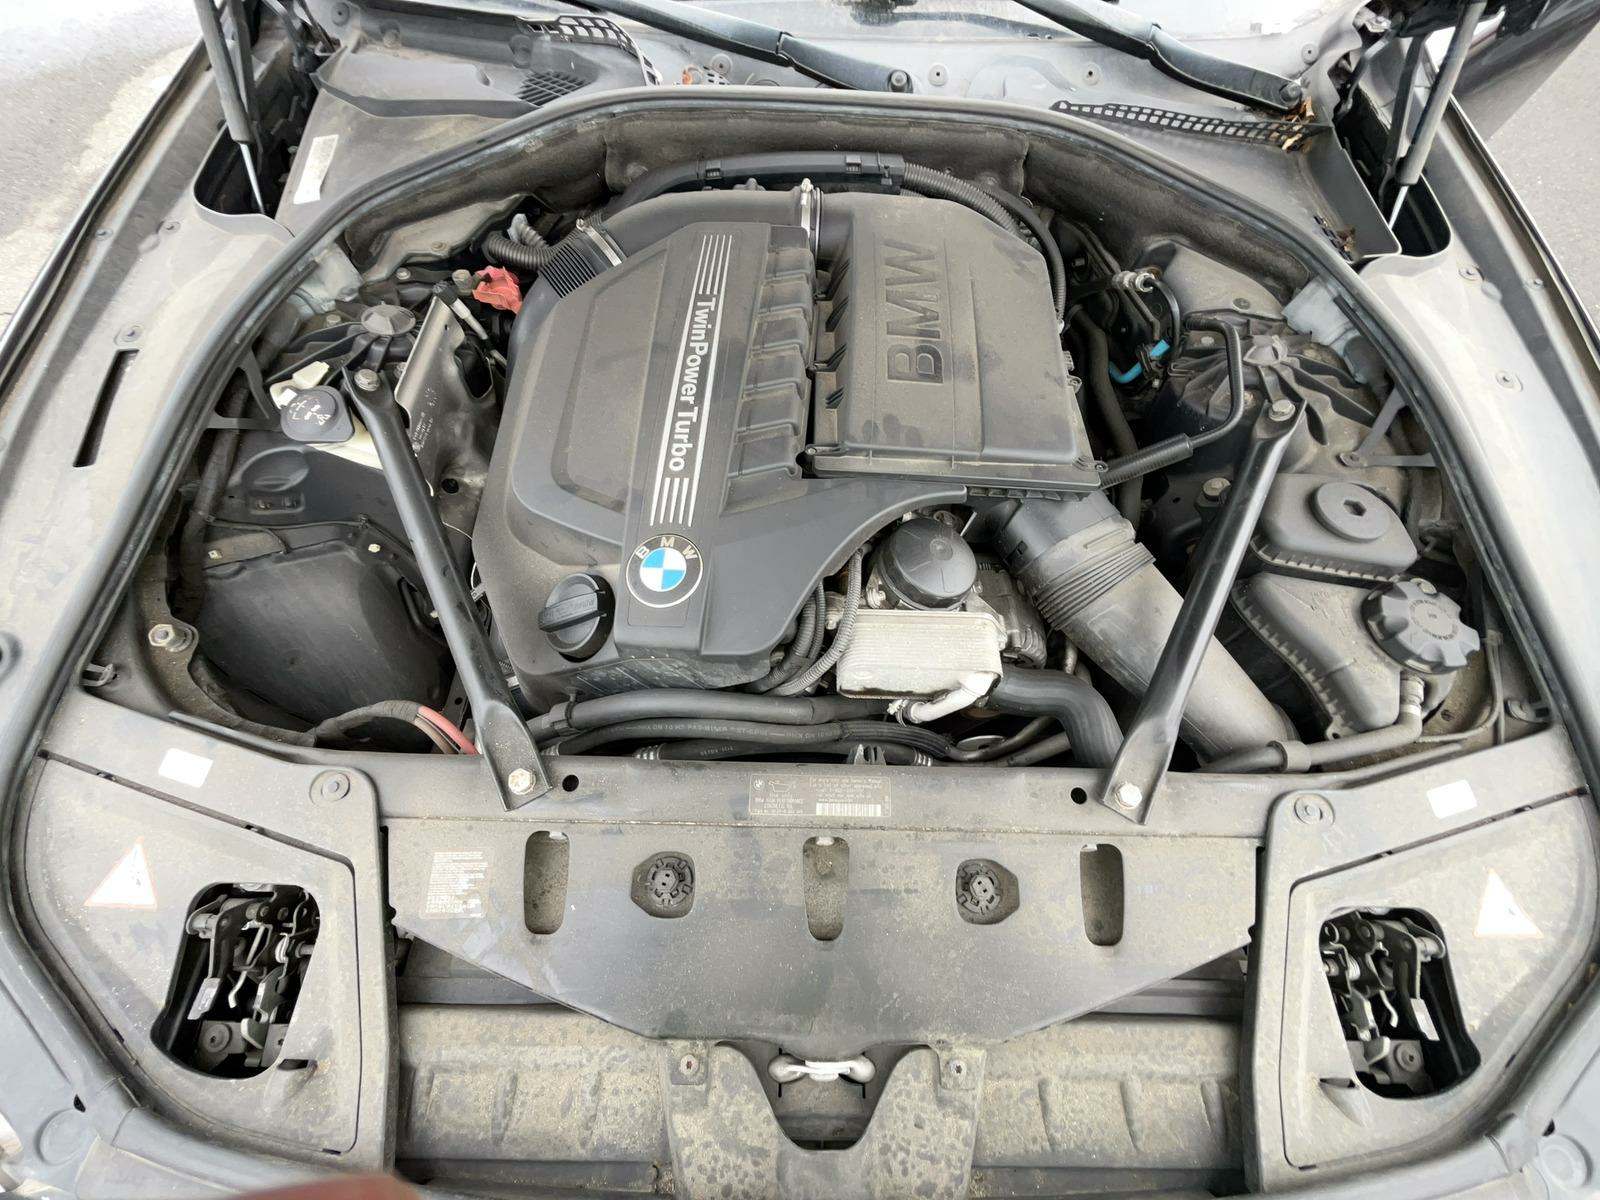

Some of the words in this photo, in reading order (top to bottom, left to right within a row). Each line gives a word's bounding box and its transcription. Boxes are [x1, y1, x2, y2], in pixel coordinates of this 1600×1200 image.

[680, 297, 716, 404] TwinPower
[882, 239, 943, 384] BMW
[669, 406, 698, 472] Turbo
[635, 536, 698, 559] BMW
